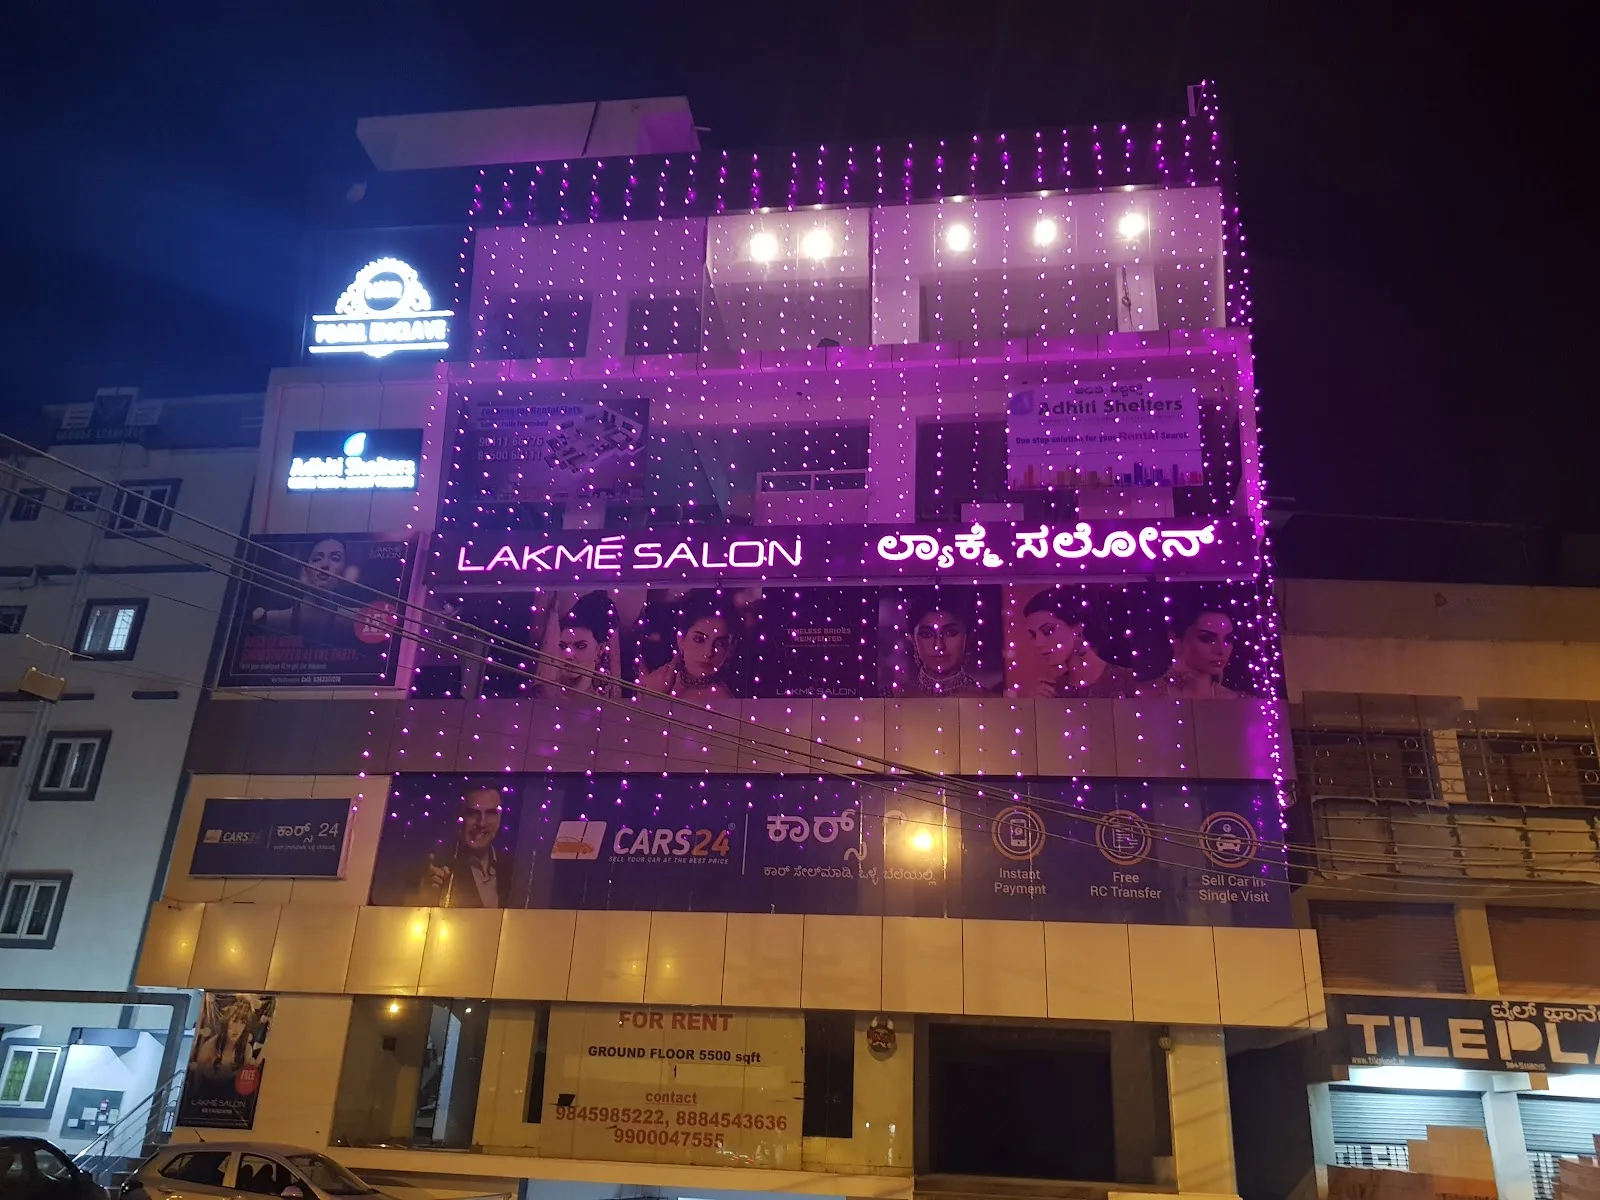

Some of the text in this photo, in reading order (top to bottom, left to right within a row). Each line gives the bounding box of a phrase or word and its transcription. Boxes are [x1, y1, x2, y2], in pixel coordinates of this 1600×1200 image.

[1104, 397, 1183, 413] Shelters
[478, 450, 509, 461] 8500
[1015, 521, 1216, 560] ಸಲೋನ್
[457, 536, 803, 571] LAKMÉ SALON
[823, 627, 852, 635] BRIDES
[816, 687, 857, 695] SALON
[318, 822, 340, 838] 24
[613, 828, 730, 857] CARS24
[763, 865, 791, 877] ಕಾರ್
[999, 868, 1041, 881] Instant
[1112, 871, 1140, 884] Free
[1201, 874, 1225, 886] Sell
[1227, 875, 1250, 887] Car
[994, 882, 1047, 896] Payment
[1090, 886, 1162, 899] RC Transfer
[1199, 889, 1271, 904] Single Visit
[618, 1010, 734, 1032] FOR RENT
[1346, 1013, 1600, 1065] TILEPL
[588, 1045, 762, 1066] GROUND FLOOR 5500 sqft
[219, 1099, 246, 1107] SALON
[644, 1090, 698, 1104] contact
[555, 1106, 788, 1132] 9845985222, 8884543636
[613, 1128, 726, 1149] 9900047555
